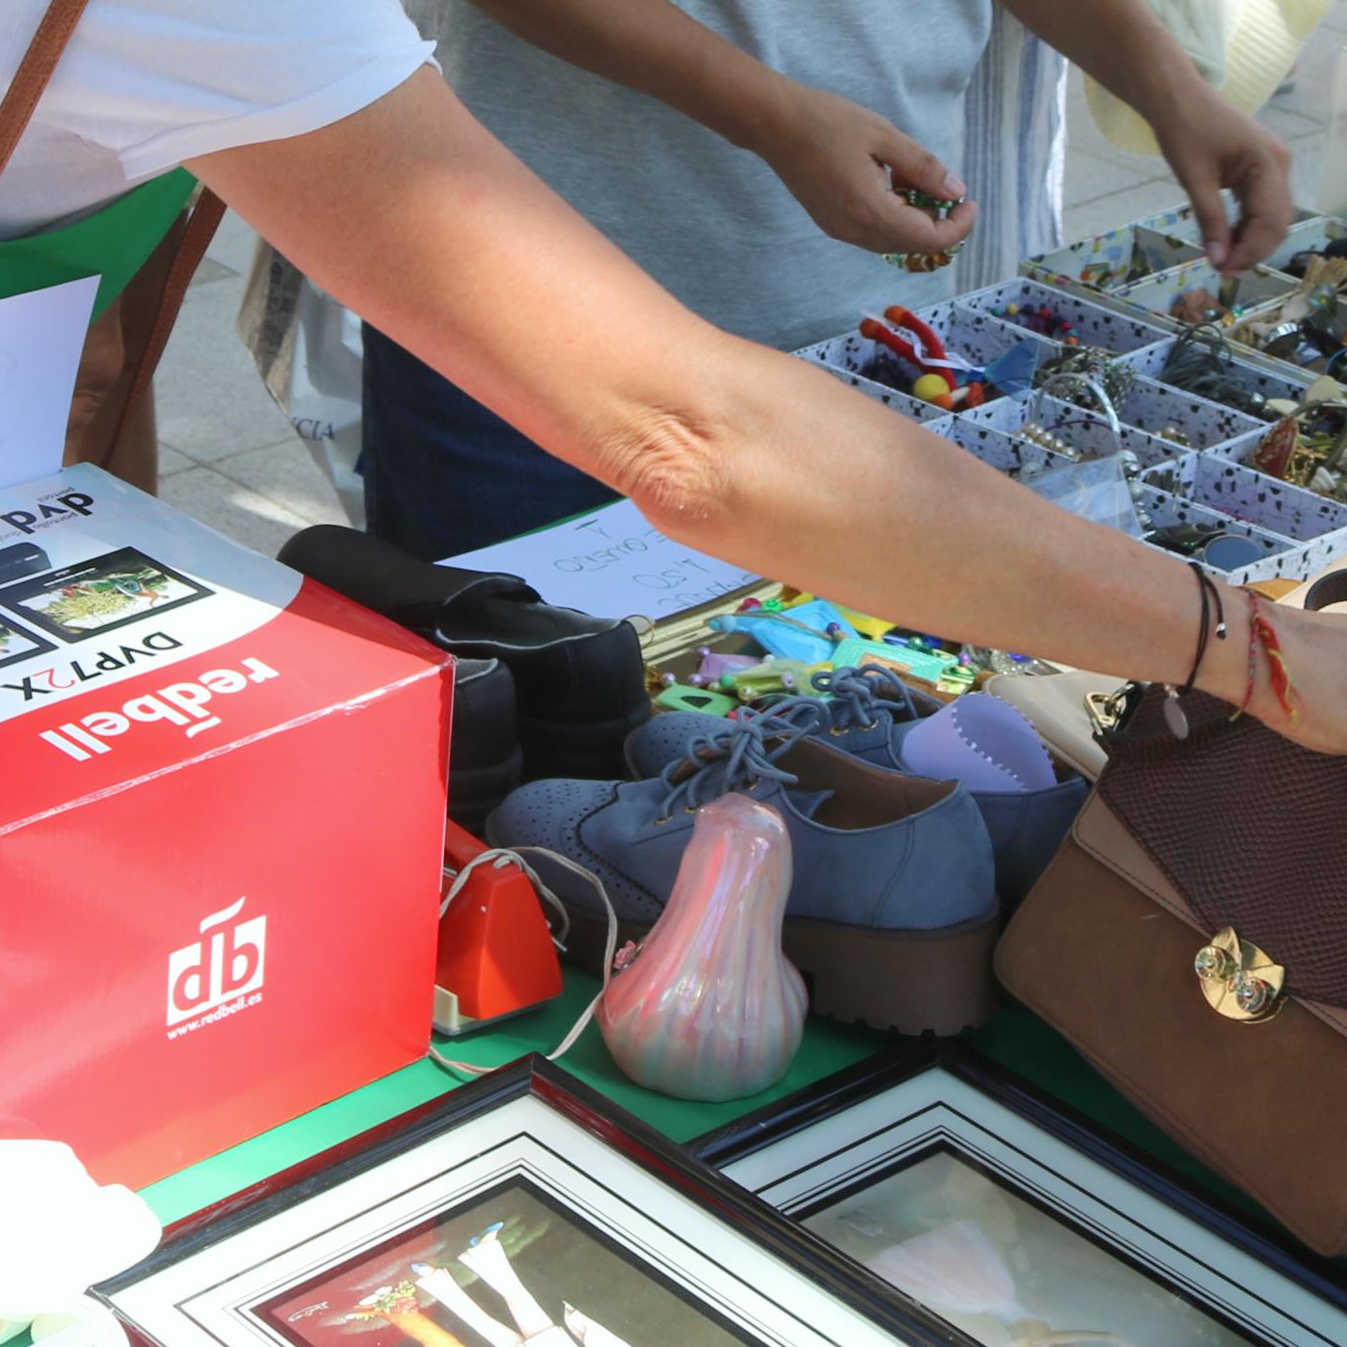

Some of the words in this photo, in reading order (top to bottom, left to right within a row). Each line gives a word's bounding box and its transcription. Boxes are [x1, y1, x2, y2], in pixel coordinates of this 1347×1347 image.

[291, 416, 334, 440] CIA
[0, 493, 94, 535] dvd
[554, 528, 668, 573] EQUEÑO
[39, 657, 280, 762] redbell
[166, 992, 263, 1041] www.redbell.es
